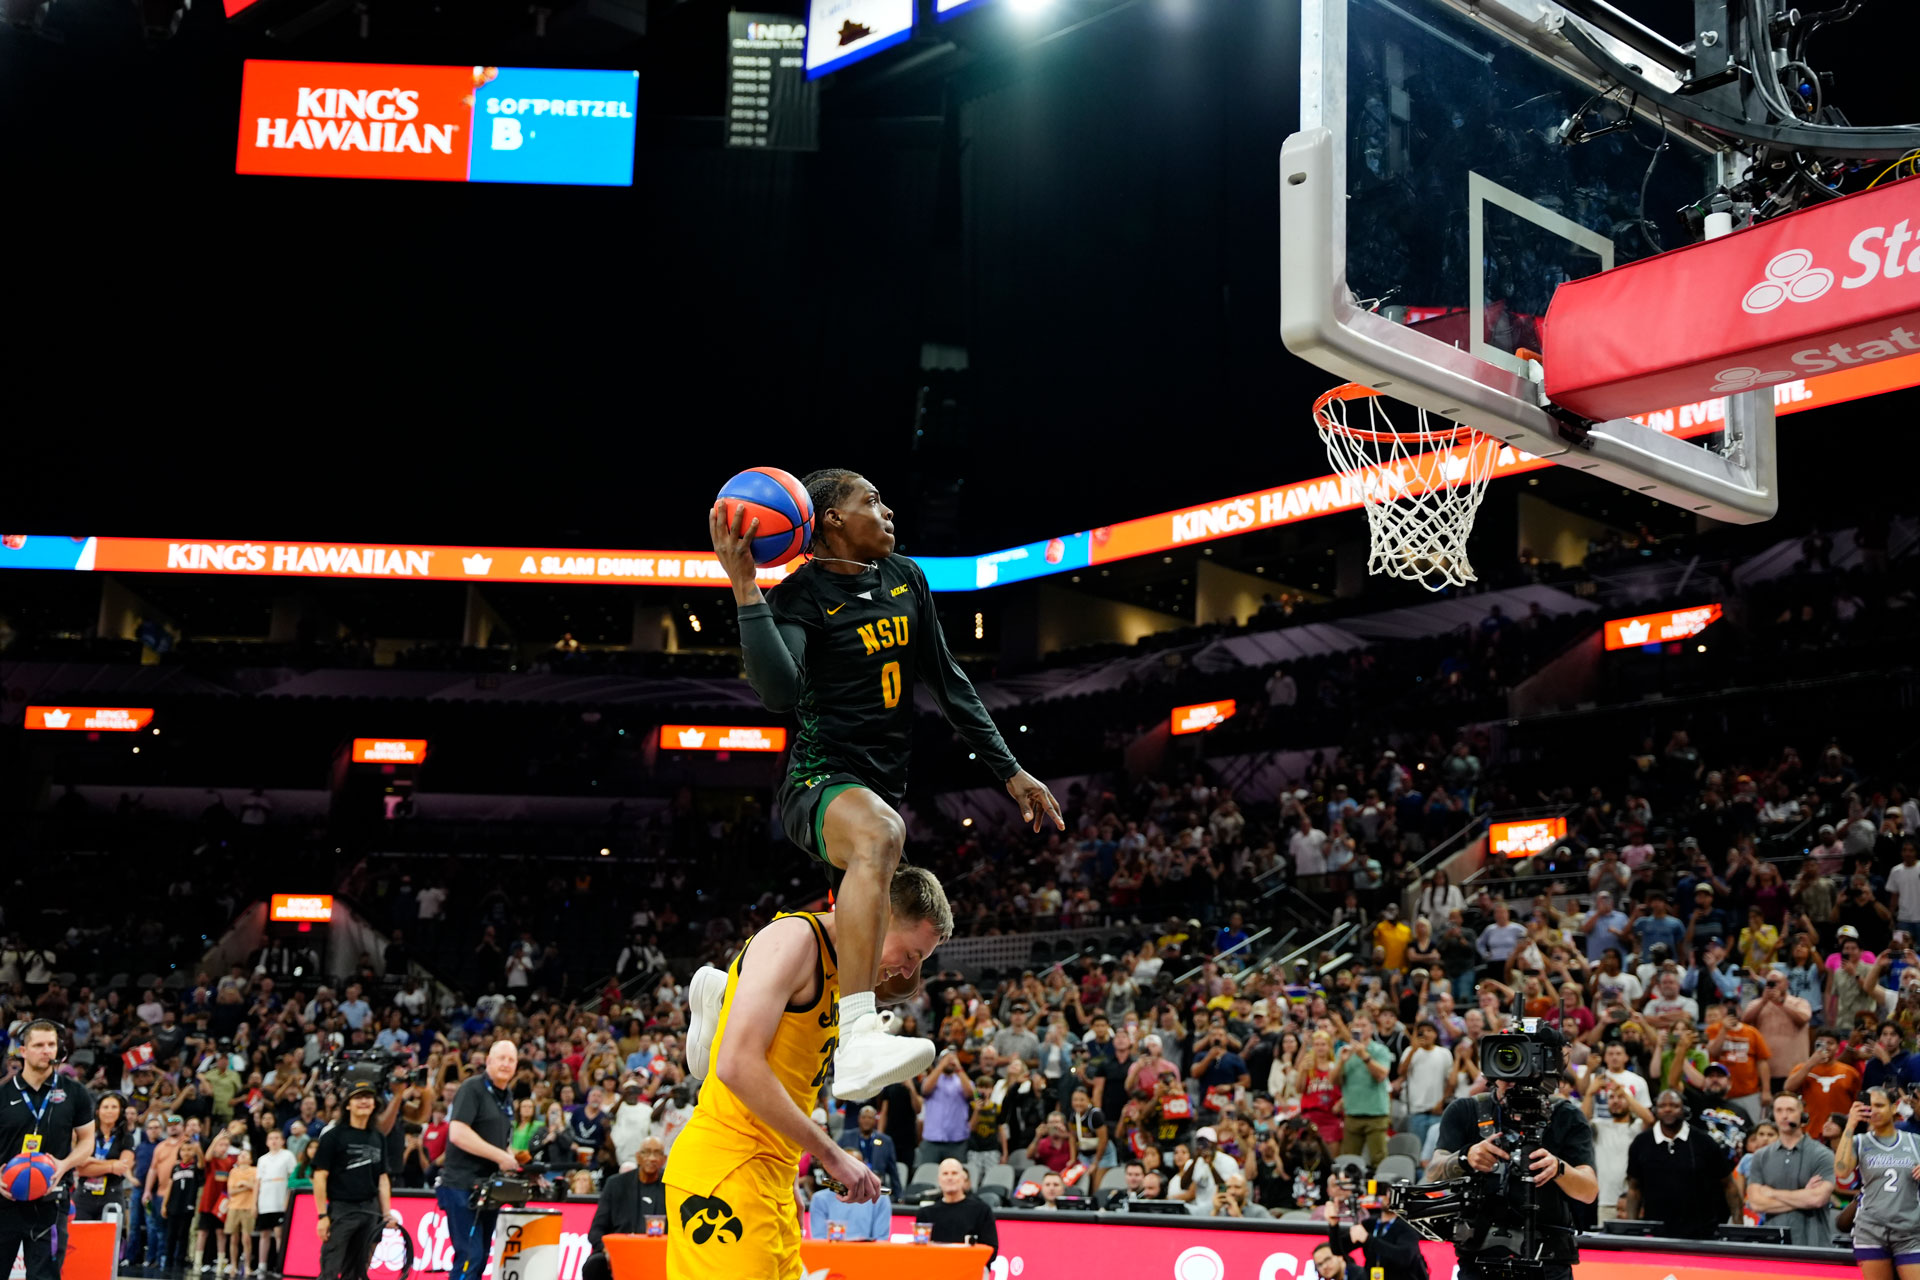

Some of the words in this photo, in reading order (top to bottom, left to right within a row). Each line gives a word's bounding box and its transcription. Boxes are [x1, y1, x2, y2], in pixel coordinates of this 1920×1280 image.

[297, 87, 419, 121] KING'S
[256, 118, 453, 154] HAWAIIAN
[491, 117, 523, 151] B
[1791, 327, 1920, 373] Stat
[1172, 498, 1255, 543] KING'S
[1260, 464, 1408, 524] HAWAIIAN
[167, 543, 266, 571] KING'S
[272, 546, 430, 576] HAWAIIAN
[520, 556, 537, 574] A
[540, 556, 595, 575] SLAM
[597, 557, 655, 577] DUNK
[657, 559, 681, 578] IN
[890, 584, 908, 597] MEAC
[857, 616, 909, 656] NSU
[881, 661, 901, 709] 0
[811, 1036, 839, 1087] 2
[1883, 1168, 1899, 1192] 2
